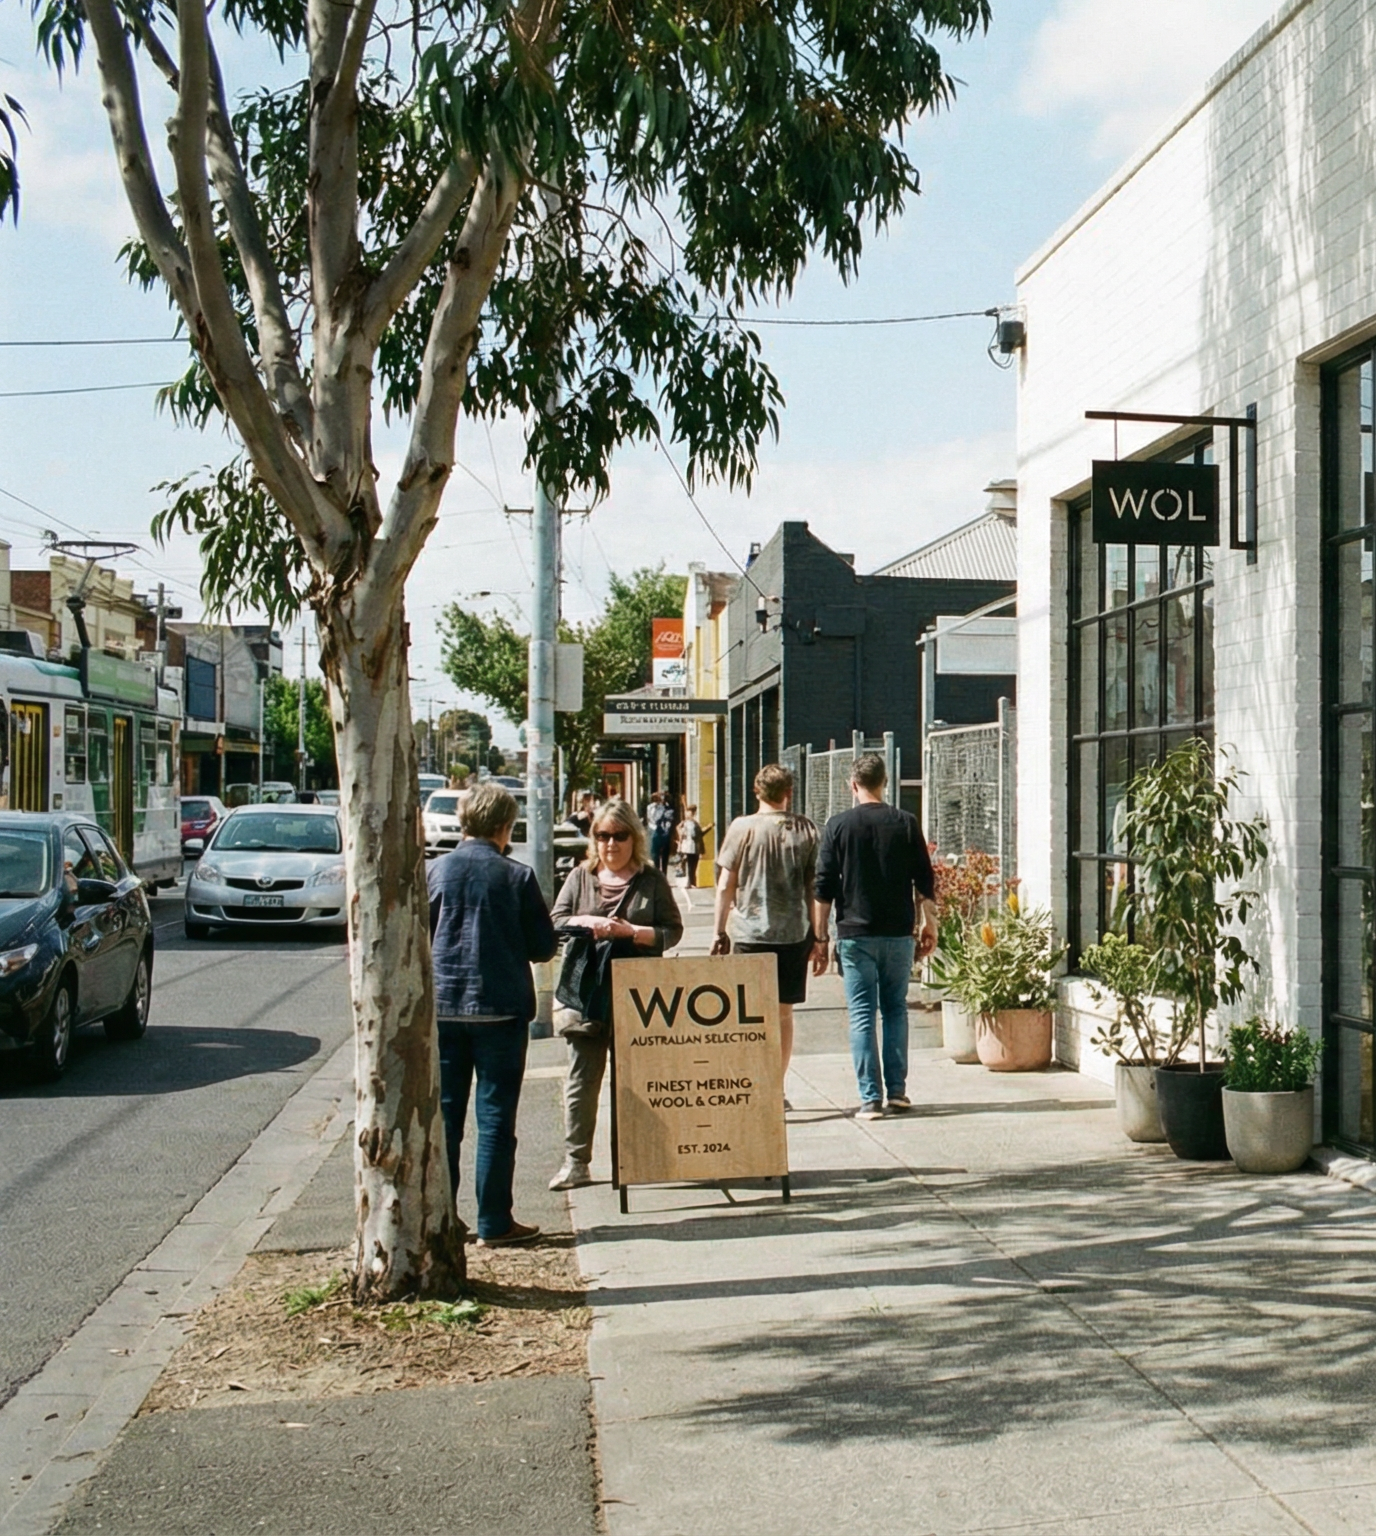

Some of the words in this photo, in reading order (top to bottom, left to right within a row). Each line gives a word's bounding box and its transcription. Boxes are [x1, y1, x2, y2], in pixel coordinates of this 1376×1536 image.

[1109, 487, 1206, 521] WOL
[629, 984, 764, 1028] WOL
[630, 1035, 702, 1047] AUSTRALIAN
[704, 1032, 766, 1044] SELECTION
[647, 1079, 692, 1092] FINEST
[649, 1096, 693, 1108] WOOL
[696, 1096, 706, 1107] &
[708, 1094, 751, 1106] CRAFT
[678, 1144, 700, 1155] EST.
[703, 1142, 731, 1153] 2024
